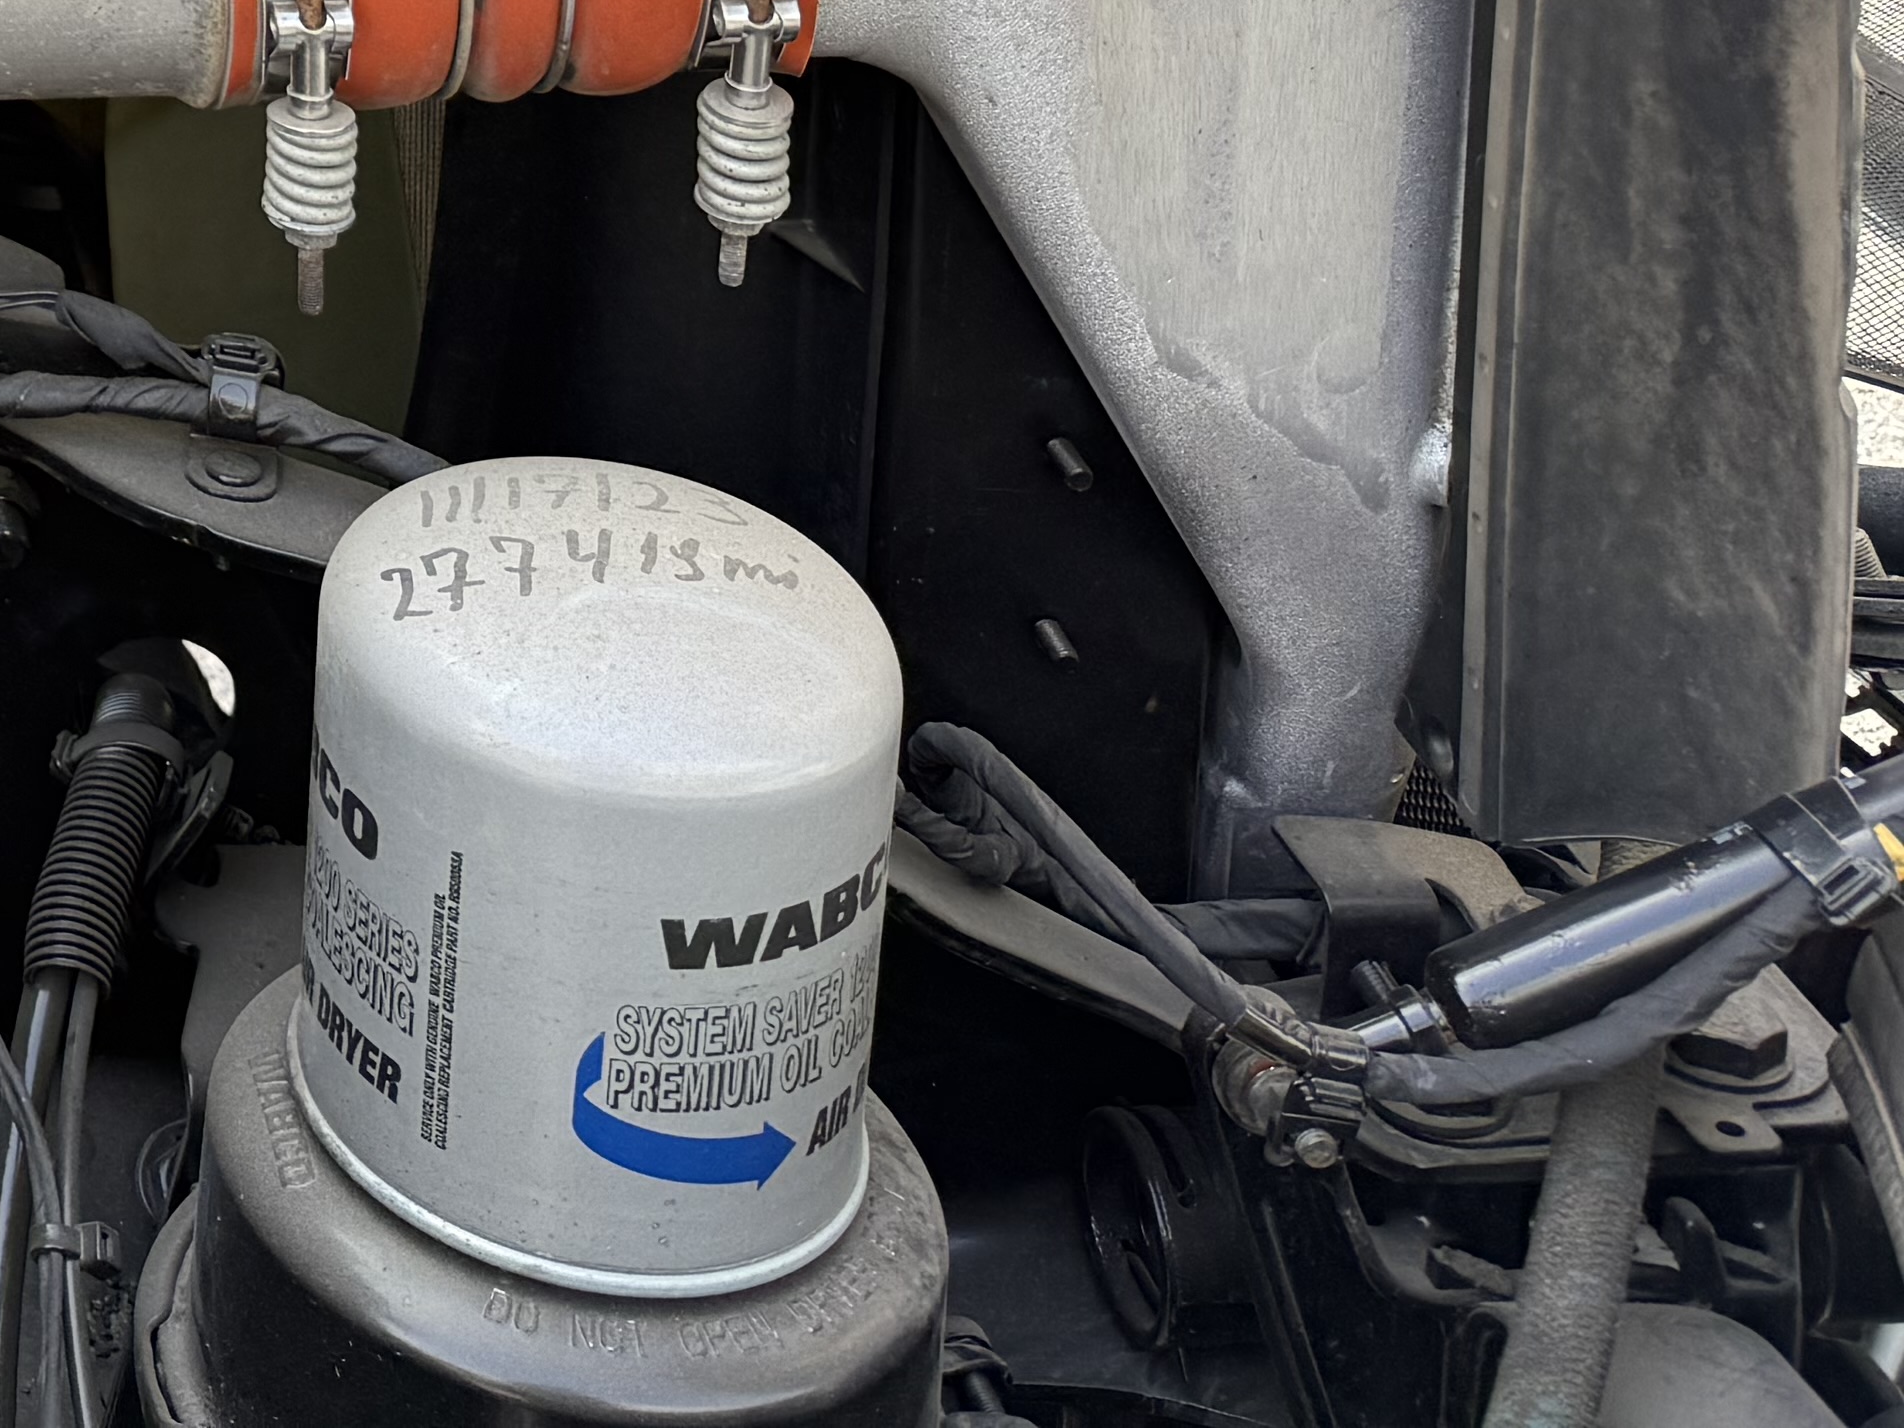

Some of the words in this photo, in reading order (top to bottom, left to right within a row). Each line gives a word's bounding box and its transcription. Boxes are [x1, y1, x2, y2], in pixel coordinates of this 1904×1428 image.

[343, 878, 420, 984] SERIES
[431, 910, 445, 960] PREMIUM
[429, 959, 442, 997] WABCO
[437, 1016, 453, 1089] REPLACEMENT
[445, 924, 458, 953] PART
[317, 980, 402, 1105] DRYER
[426, 999, 440, 1045] GENUINE
[614, 1001, 758, 1059] SYSTEM
[762, 967, 844, 1046] SAVER
[423, 1072, 436, 1100] ONLY
[425, 1044, 437, 1073] WITH
[606, 1051, 774, 1114] PREMIUM
[779, 1034, 822, 1094] OIL
[421, 1098, 434, 1143] SERVICE
[805, 1084, 852, 1156] AIR
